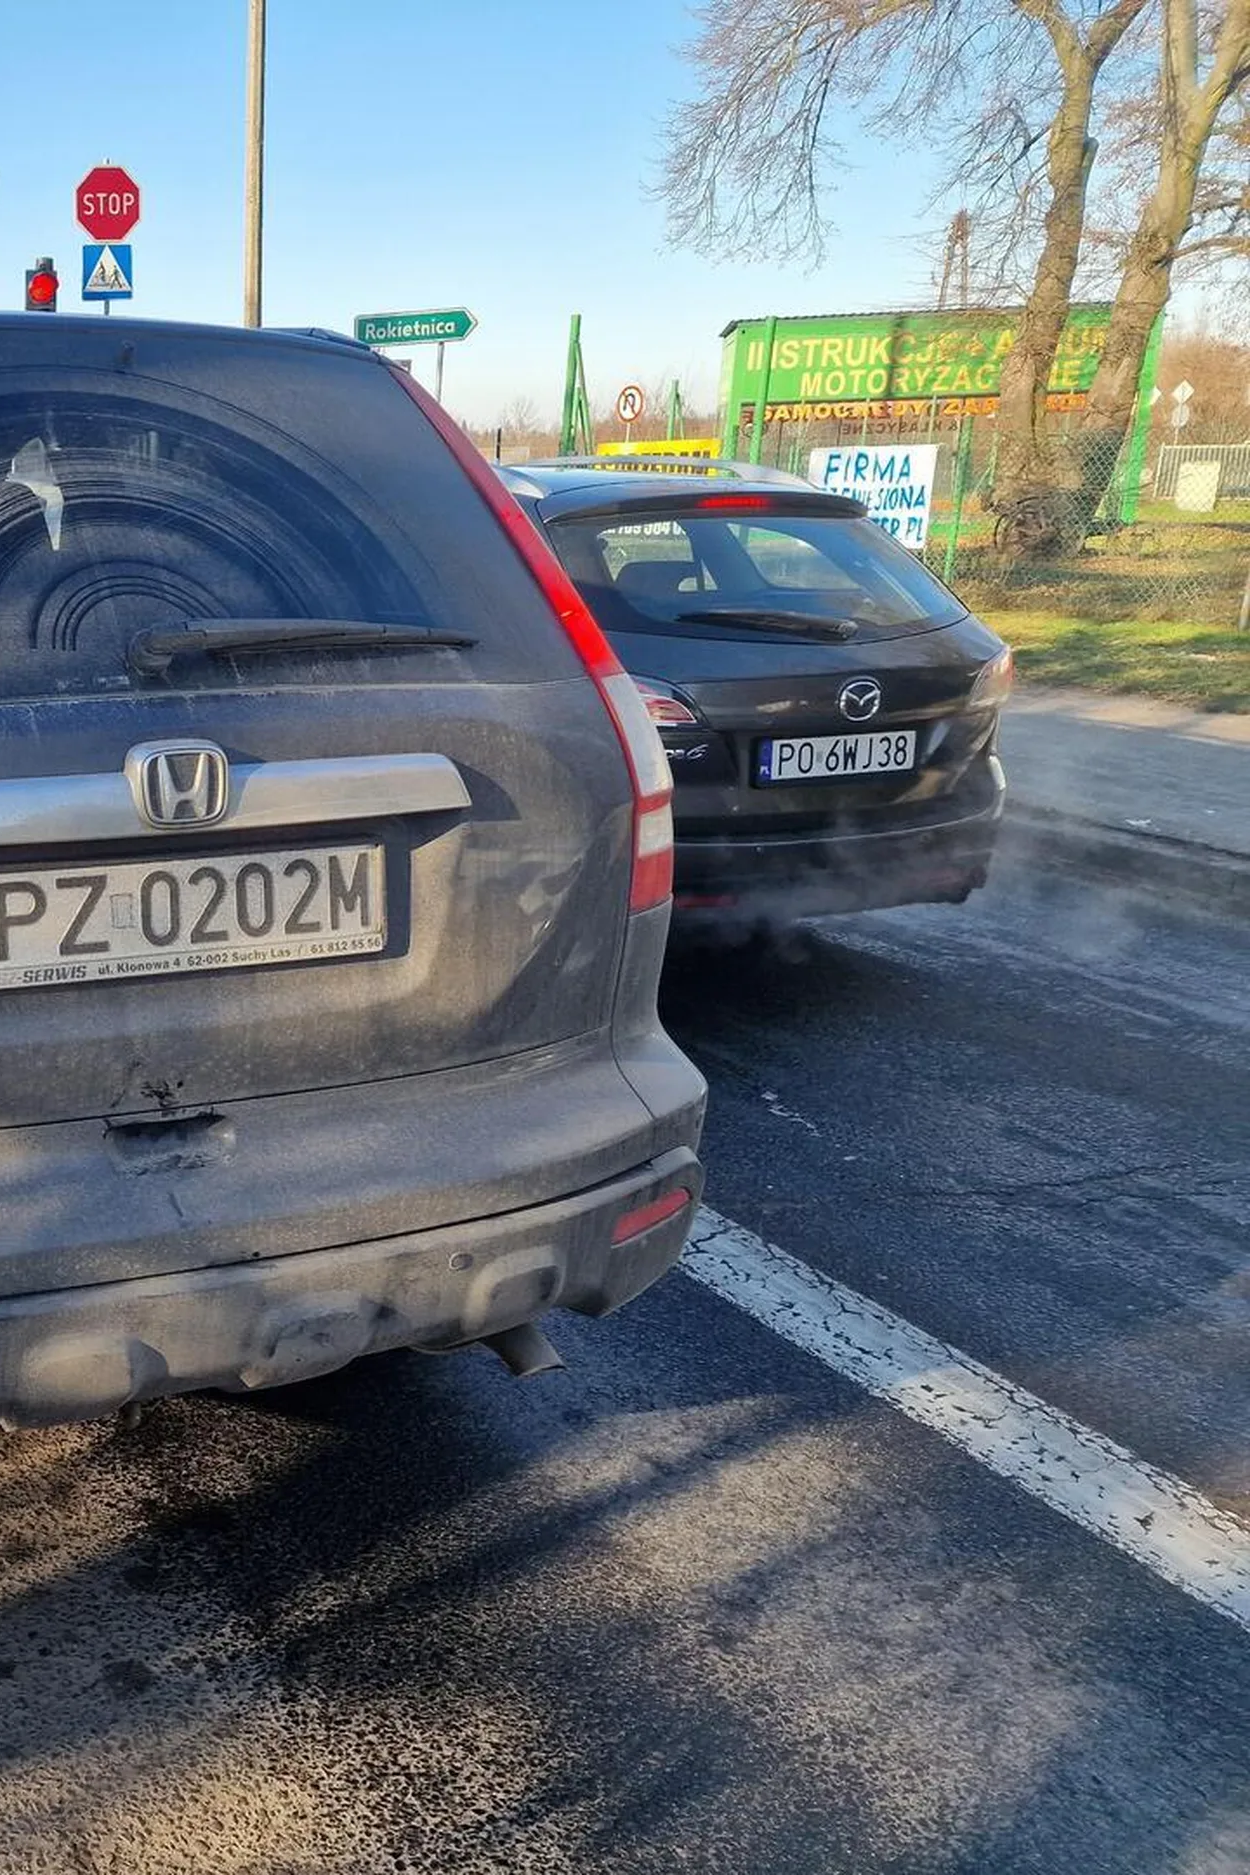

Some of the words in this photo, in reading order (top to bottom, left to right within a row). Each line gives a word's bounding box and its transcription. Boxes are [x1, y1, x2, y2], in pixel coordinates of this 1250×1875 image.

[83, 192, 135, 216] STOP
[365, 318, 456, 340] Rokietnica
[824, 452, 911, 485] FIRMA
[778, 742, 814, 776] PO
[825, 735, 908, 772] 6WJ38
[140, 852, 369, 947] 0202M
[117, 961, 170, 974] Klonowa
[173, 959, 181, 968] 4
[187, 954, 229, 967] 62-002
[232, 950, 267, 963] Suchy
[270, 948, 291, 959] Las
[310, 943, 325, 955] 61
[328, 941, 348, 952] 812
